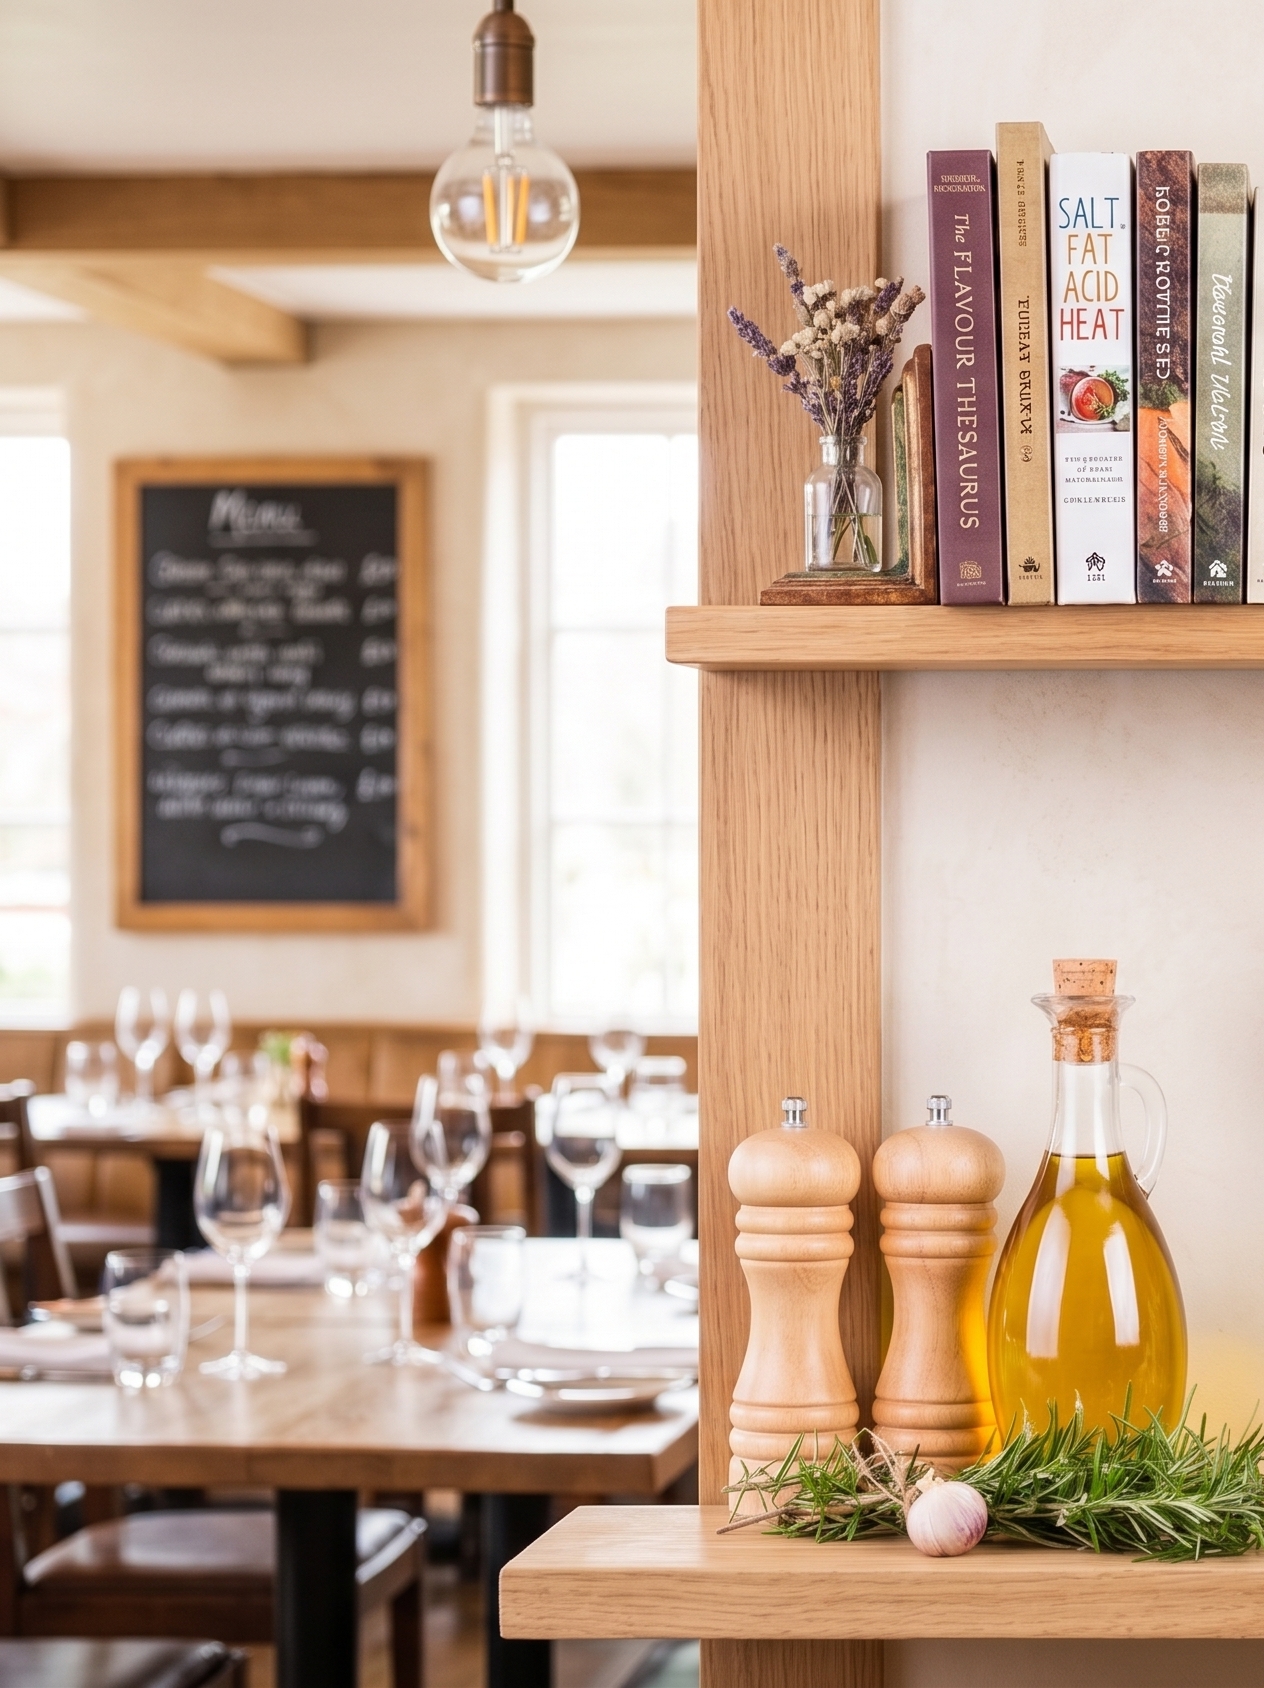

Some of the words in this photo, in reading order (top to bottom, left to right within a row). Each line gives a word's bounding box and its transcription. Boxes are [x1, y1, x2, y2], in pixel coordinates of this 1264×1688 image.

[953, 212, 969, 243] The
[1058, 196, 1120, 230] SALT
[1067, 232, 1113, 265] FAT
[1063, 269, 1119, 304] ACID
[953, 250, 975, 370] FLAVOUR
[1059, 307, 1125, 342] HEAT
[956, 377, 980, 529] THESAURUS
